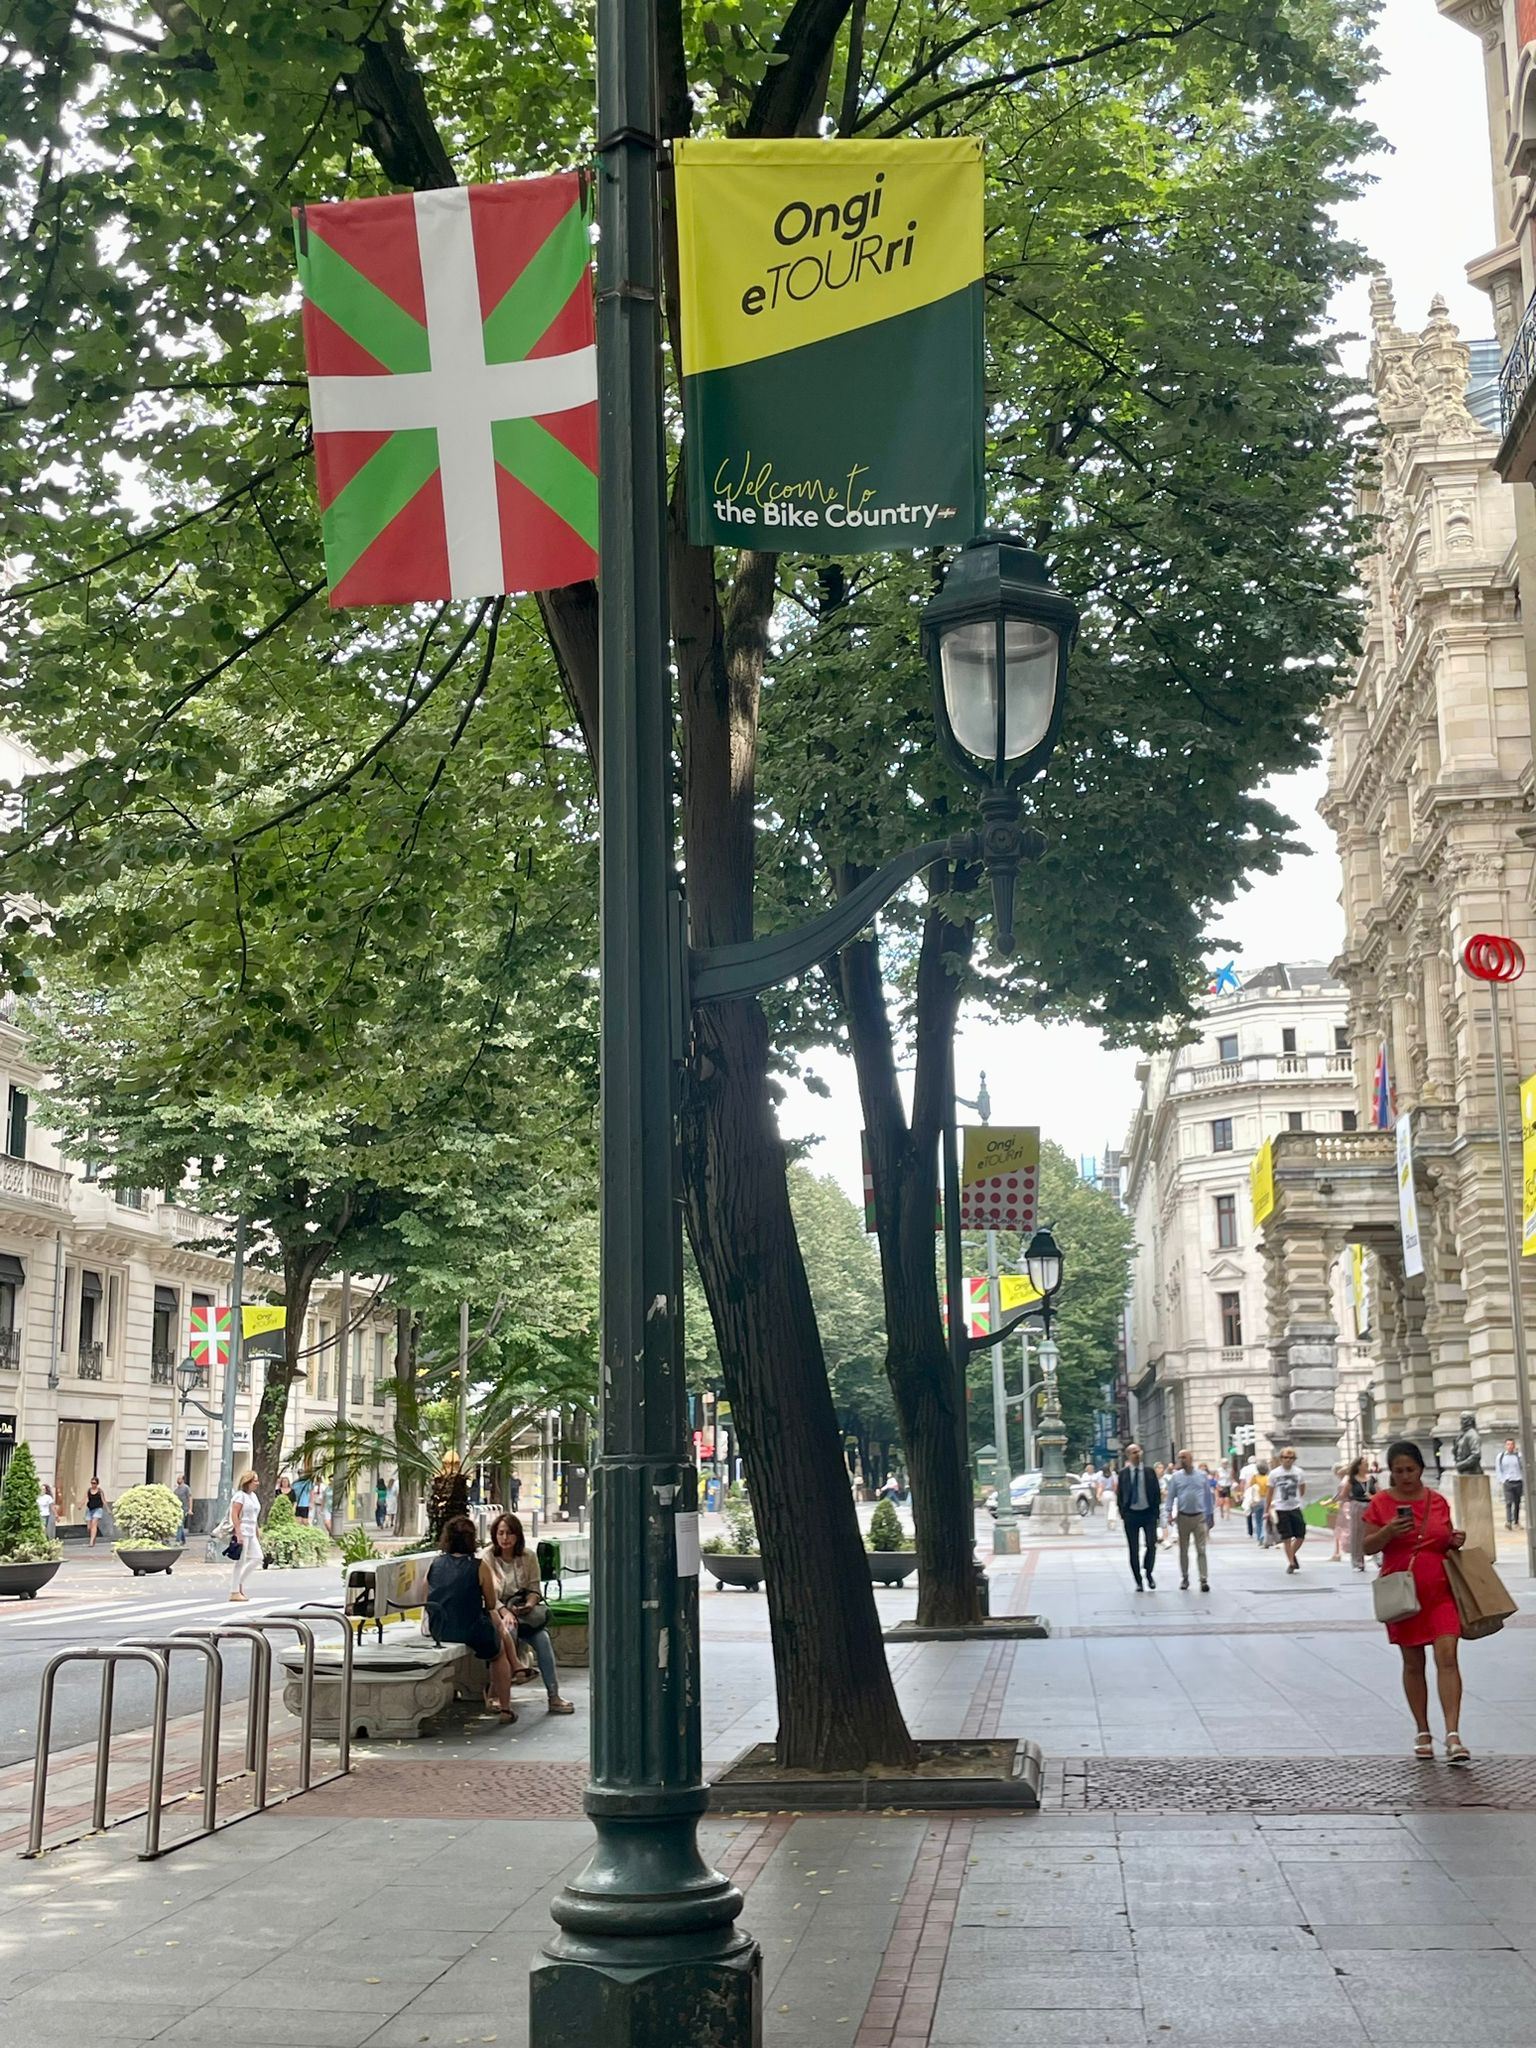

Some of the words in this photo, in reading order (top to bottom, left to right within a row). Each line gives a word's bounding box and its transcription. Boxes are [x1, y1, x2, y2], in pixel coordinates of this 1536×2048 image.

[774, 172, 885, 246] Ongi
[741, 220, 917, 316] eTOURri
[713, 450, 838, 508] Welcome
[847, 463, 877, 514] to
[713, 498, 756, 525] the
[763, 502, 819, 527] Bike
[825, 502, 939, 528] Country
[977, 1146, 1024, 1170] eTOURri
[986, 1134, 1016, 1152] Ongi
